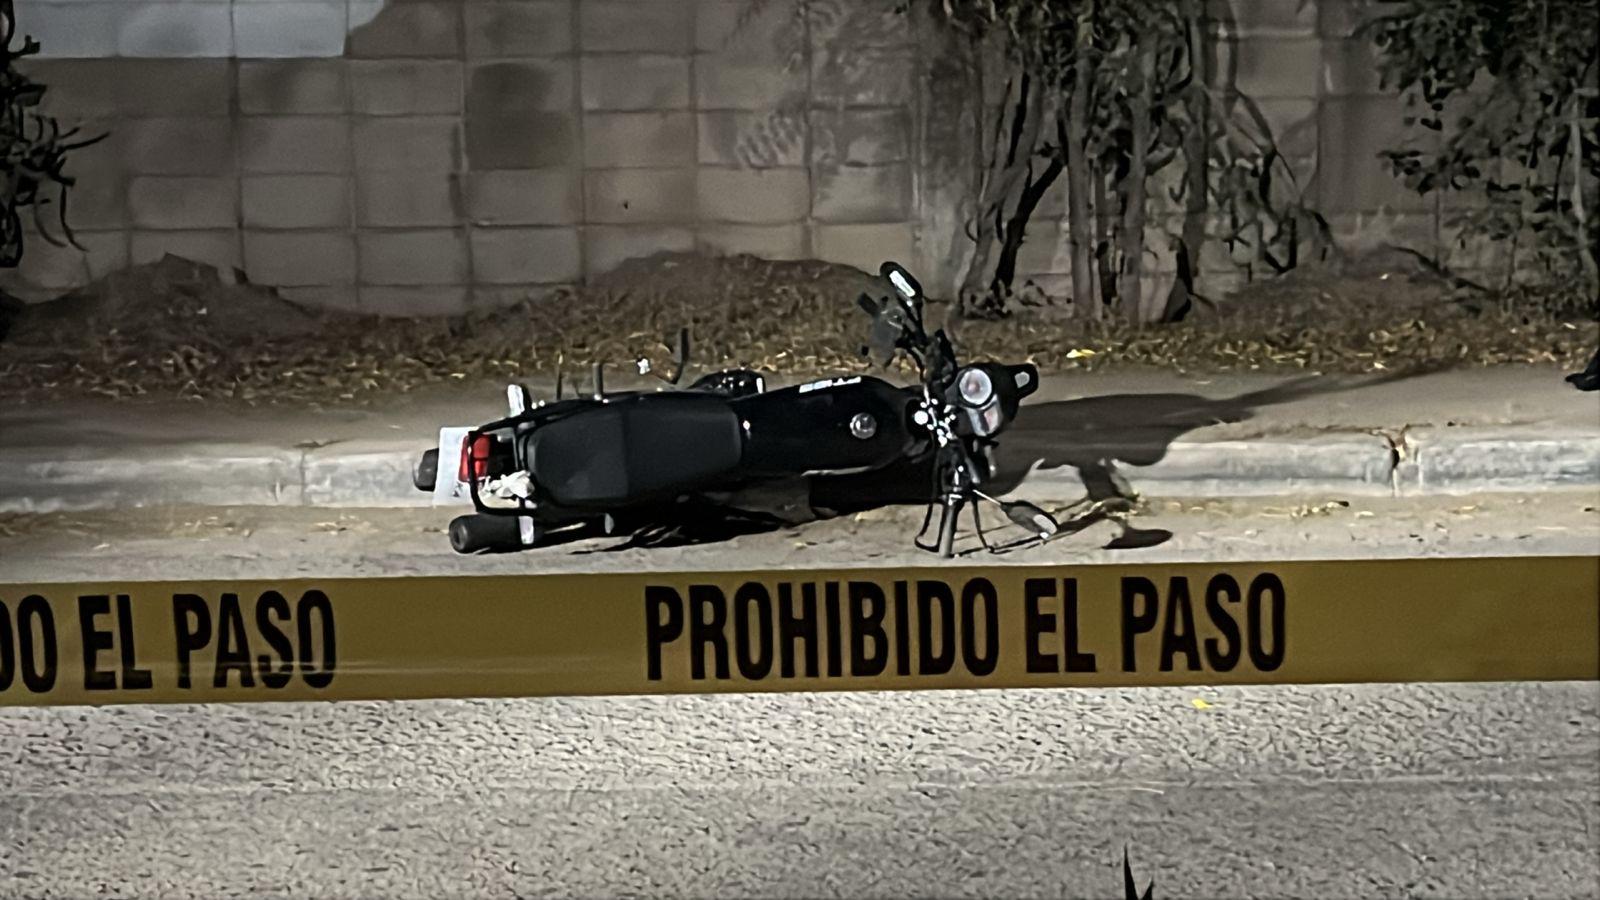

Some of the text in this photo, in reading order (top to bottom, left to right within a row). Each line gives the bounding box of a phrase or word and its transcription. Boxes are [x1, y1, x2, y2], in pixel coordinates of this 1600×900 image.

[77, 594, 153, 691] EL
[172, 589, 337, 690] PASO
[644, 573, 1287, 682] PROHIBIDO EL PASO
